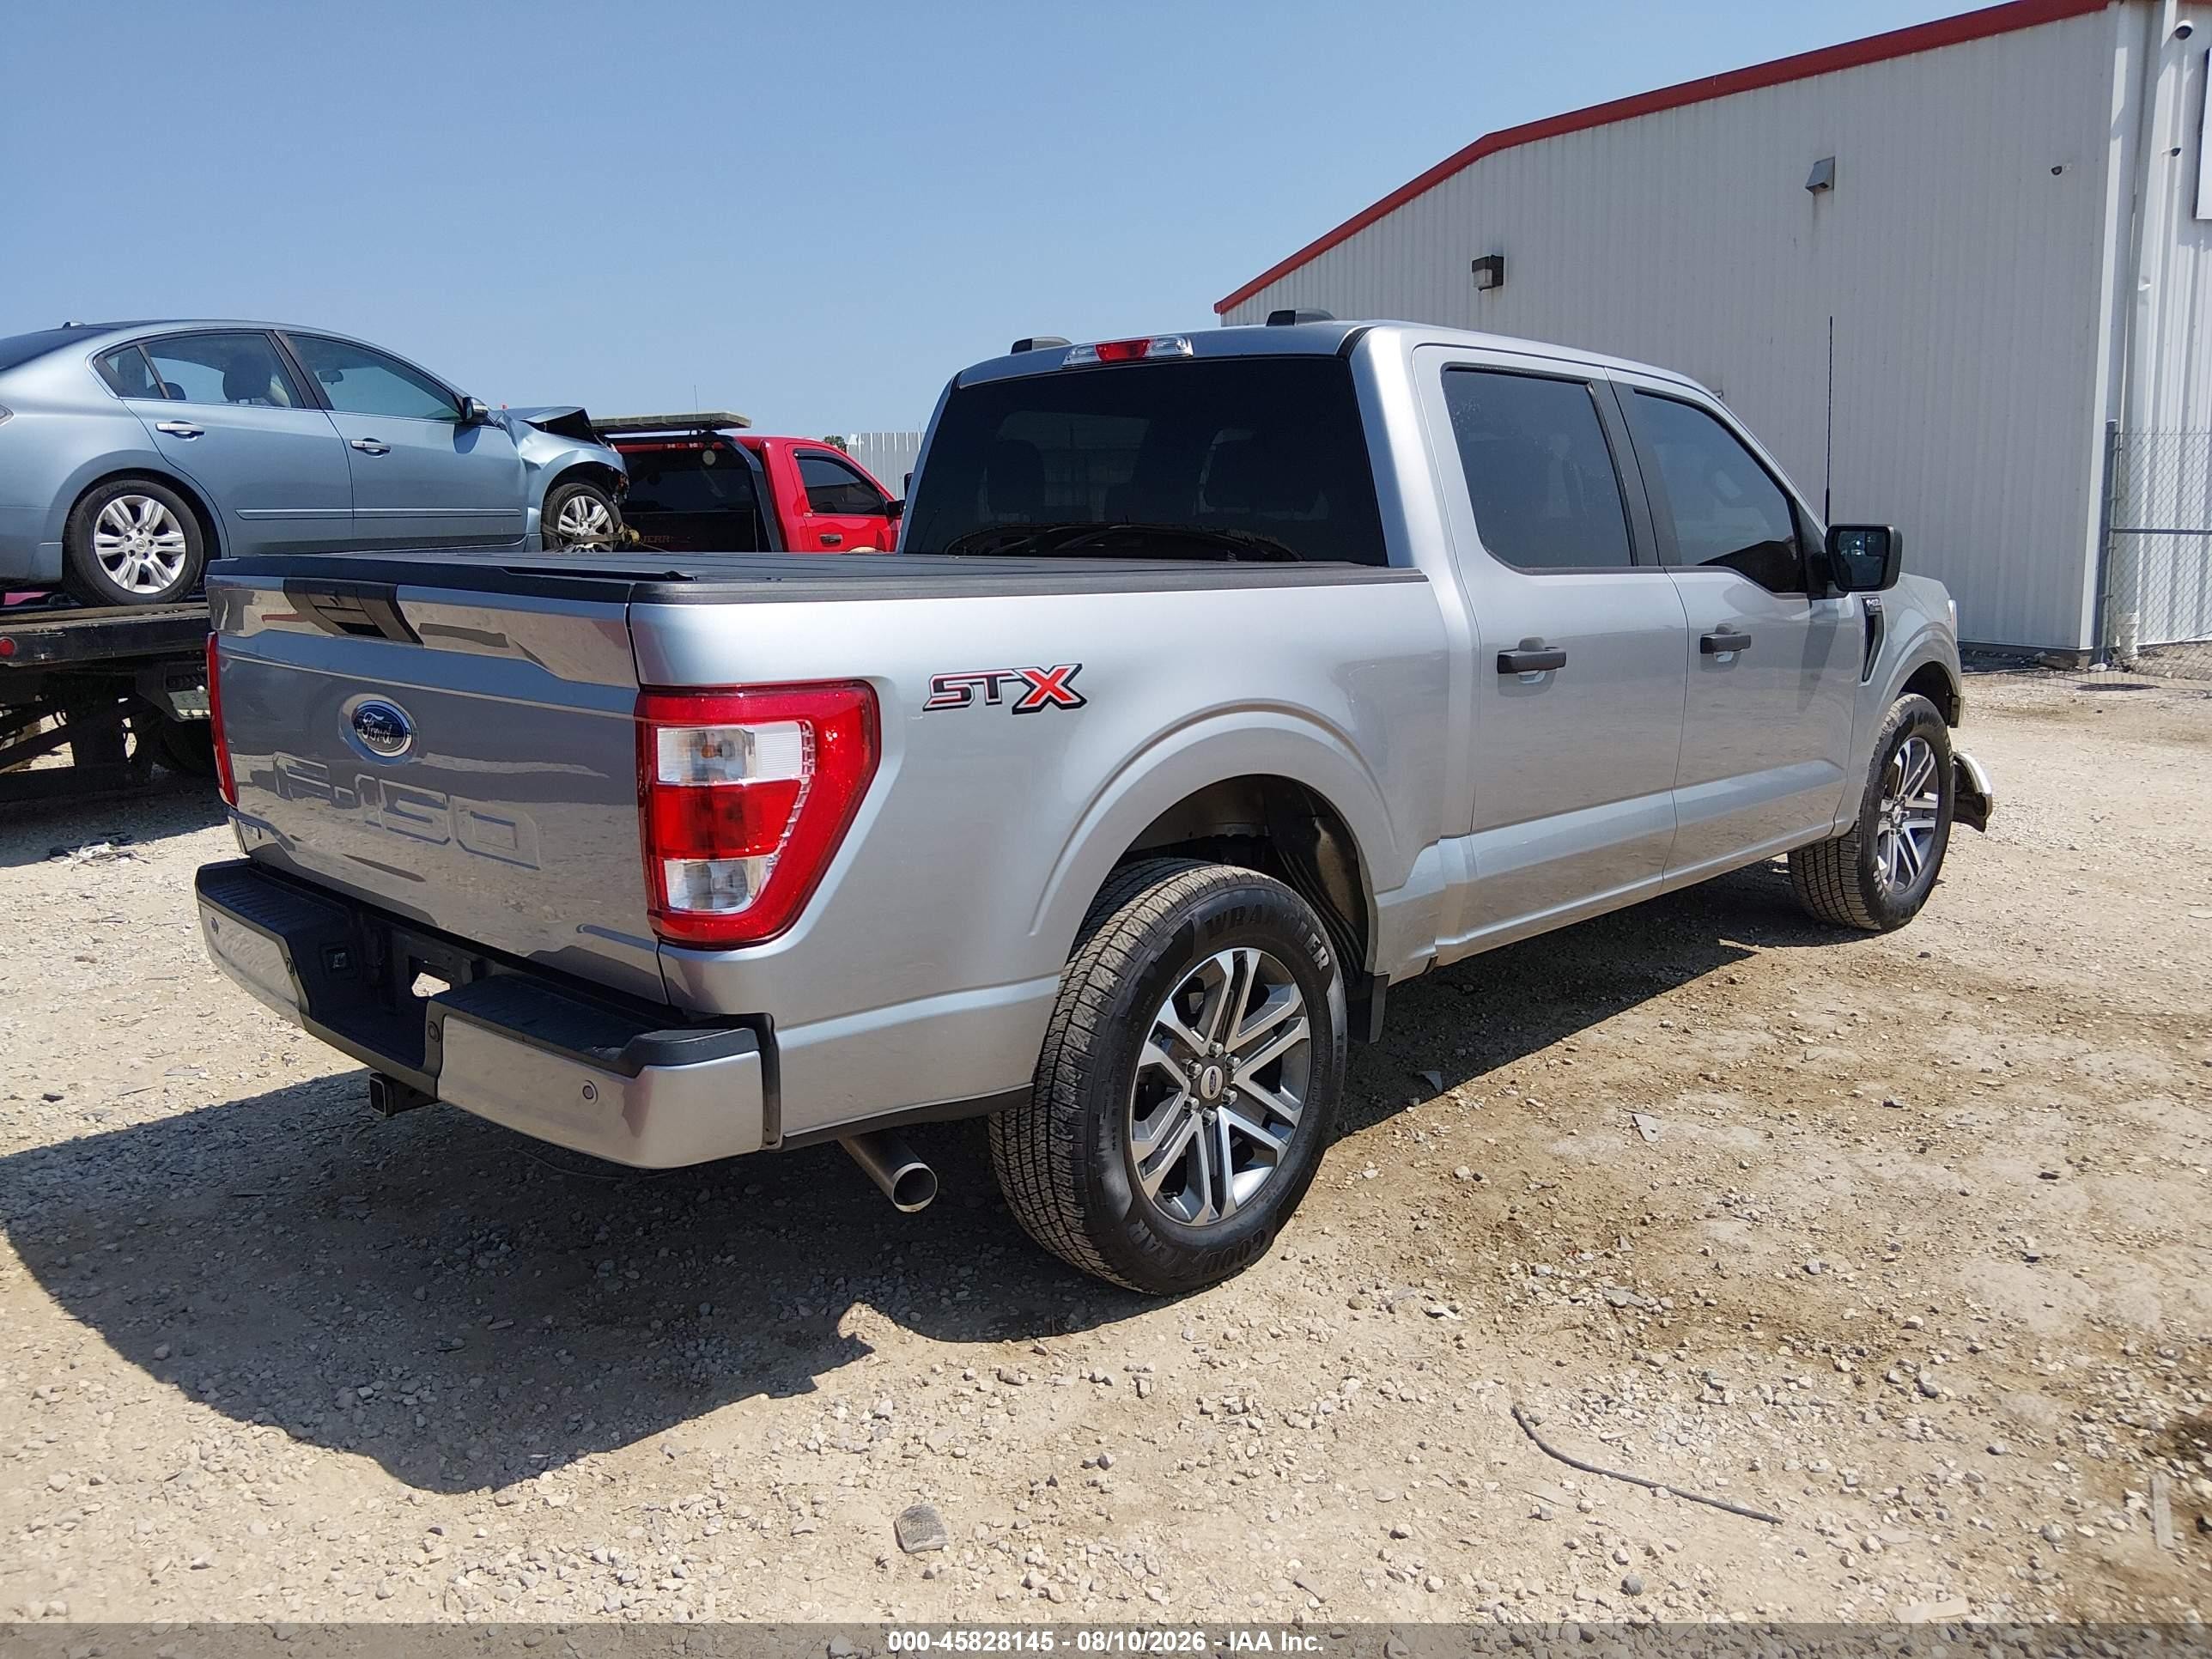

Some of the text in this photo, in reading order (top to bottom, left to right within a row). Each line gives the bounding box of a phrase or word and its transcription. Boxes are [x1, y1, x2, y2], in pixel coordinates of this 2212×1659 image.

[922, 663, 1087, 714] STX
[361, 712, 393, 744] Ford
[272, 750, 542, 871] F-150
[1204, 904, 1330, 971] WRANLER
